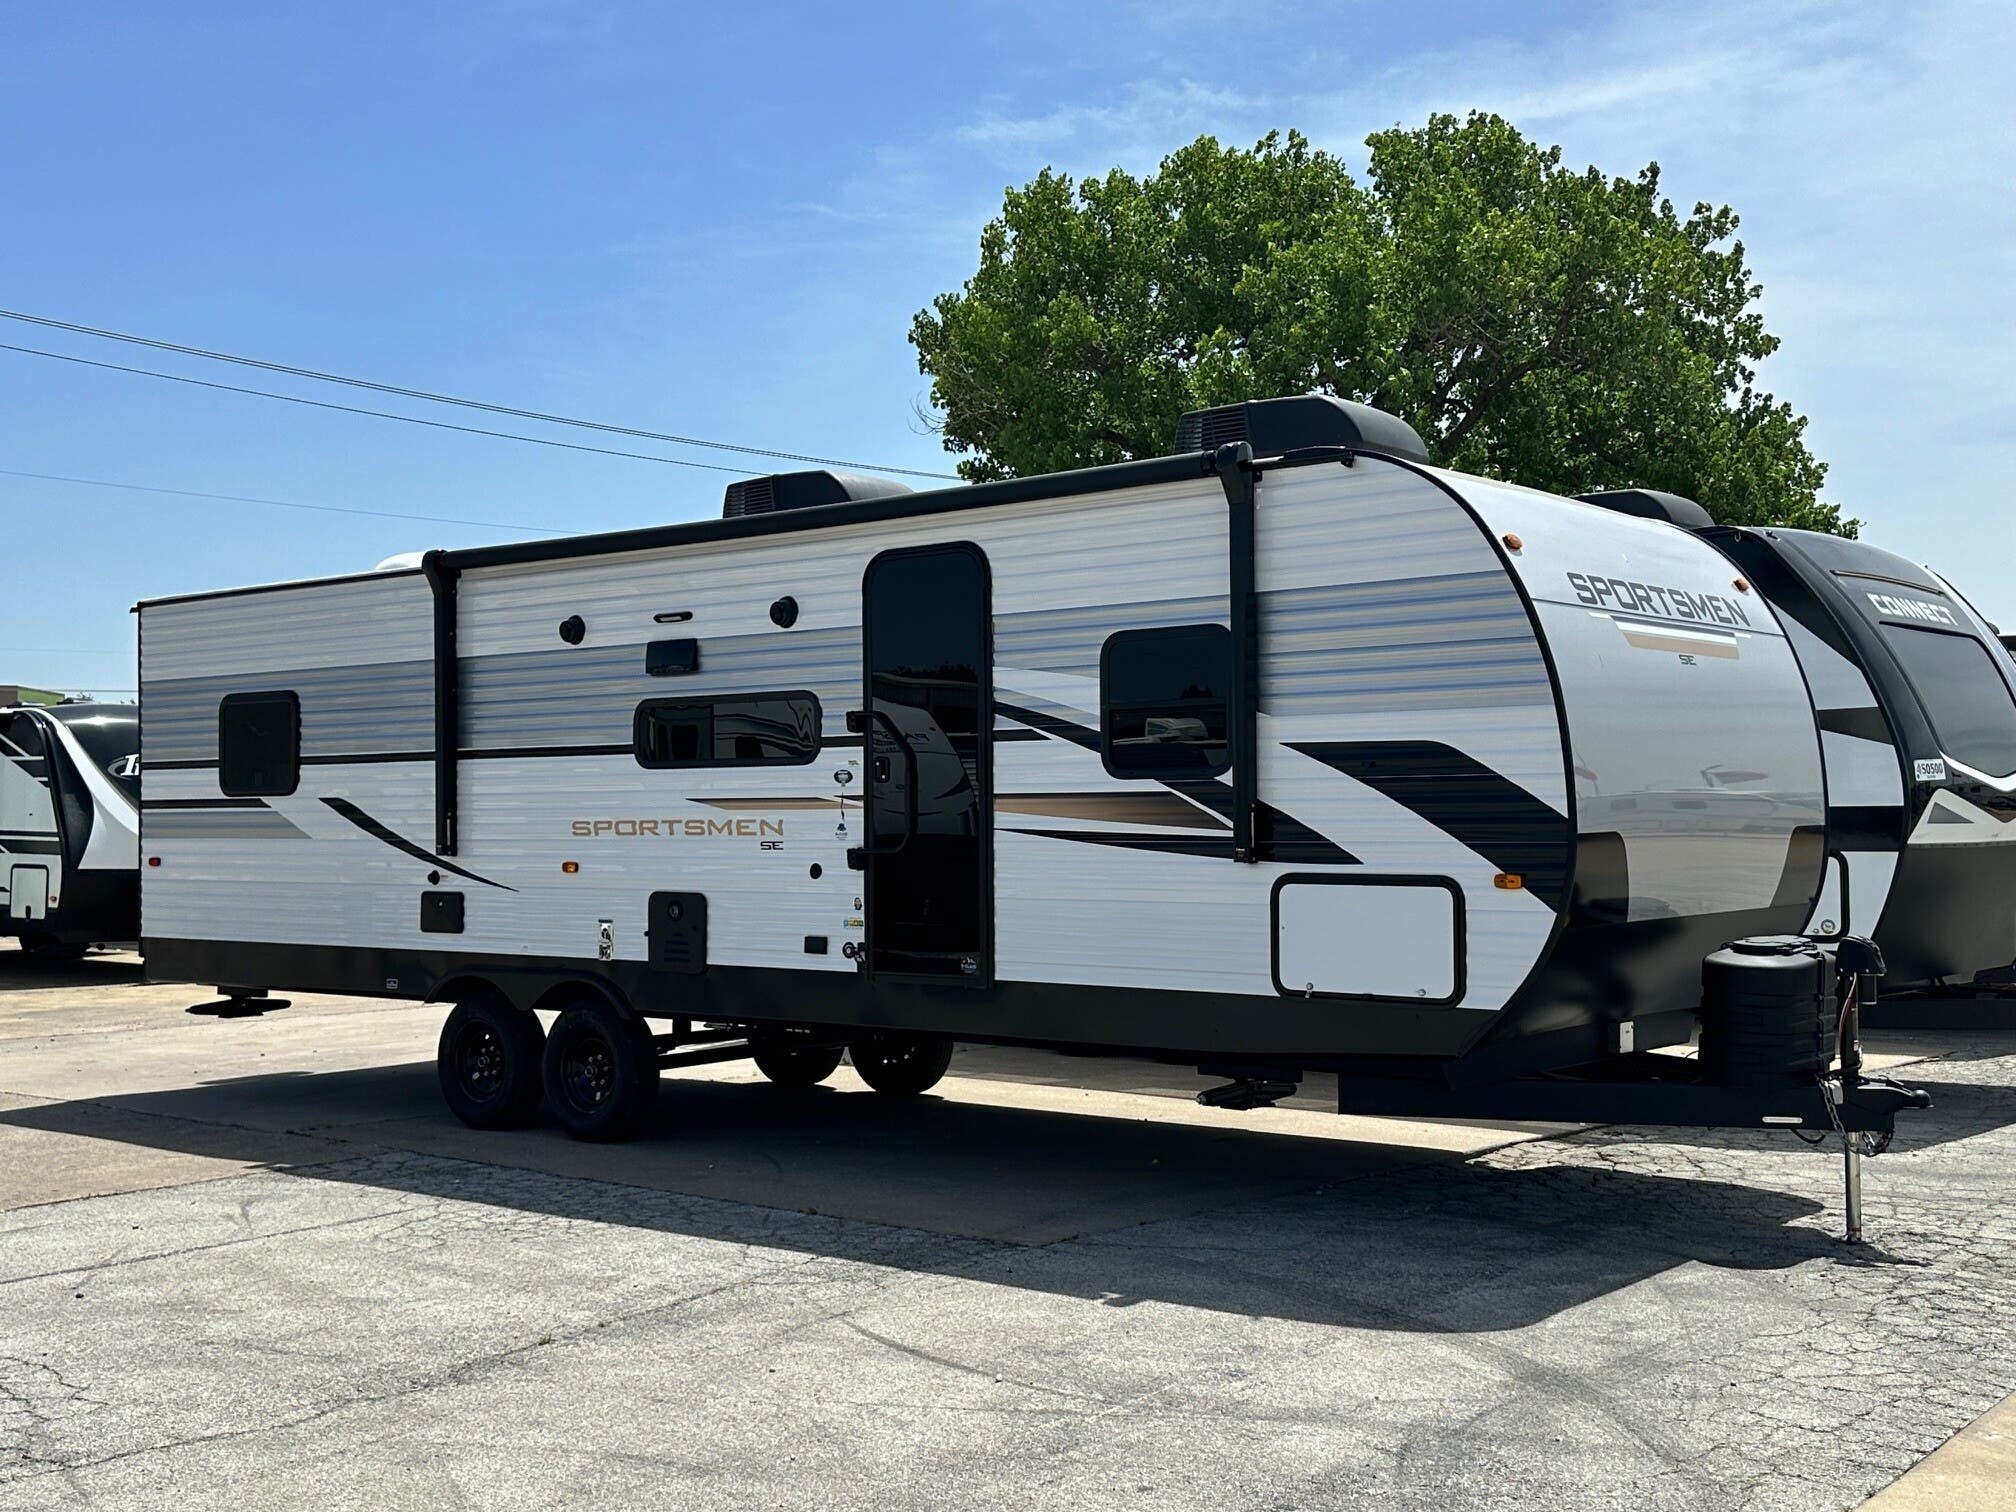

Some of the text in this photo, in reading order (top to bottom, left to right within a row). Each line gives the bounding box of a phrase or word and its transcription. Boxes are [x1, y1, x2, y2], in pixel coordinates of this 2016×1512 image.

[1566, 572, 1752, 627] SPORTSMEN
[1865, 592, 1959, 626] CONNECT
[1678, 654, 1697, 666] SE
[571, 819, 785, 837] SPORTSMEN
[760, 840, 785, 851] SE
